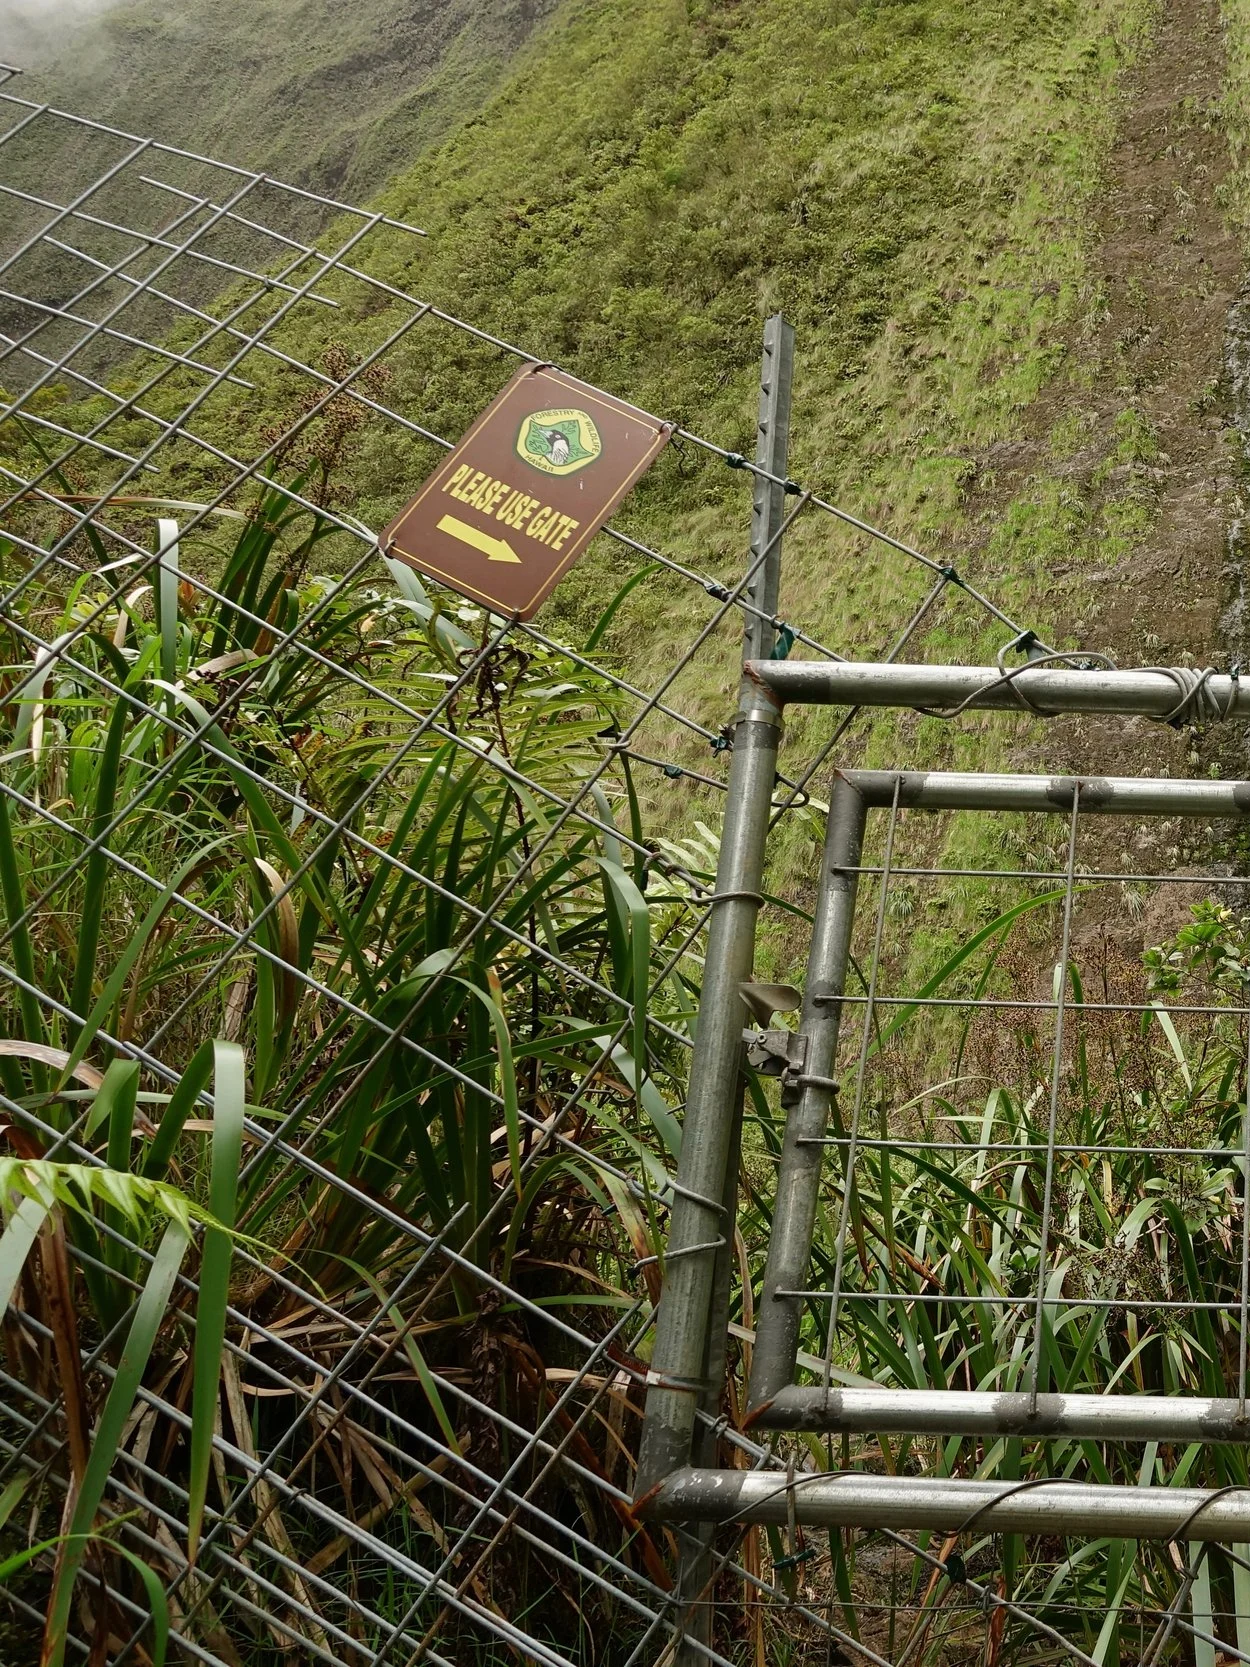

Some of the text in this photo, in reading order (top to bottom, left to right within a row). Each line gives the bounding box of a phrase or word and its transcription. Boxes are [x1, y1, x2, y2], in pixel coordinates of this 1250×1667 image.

[530, 410, 575, 421] FORESTRY
[584, 420, 600, 453] WILDLIFE
[525, 454, 554, 472] HAWAII
[441, 463, 580, 551] PLEASE USE GATE
